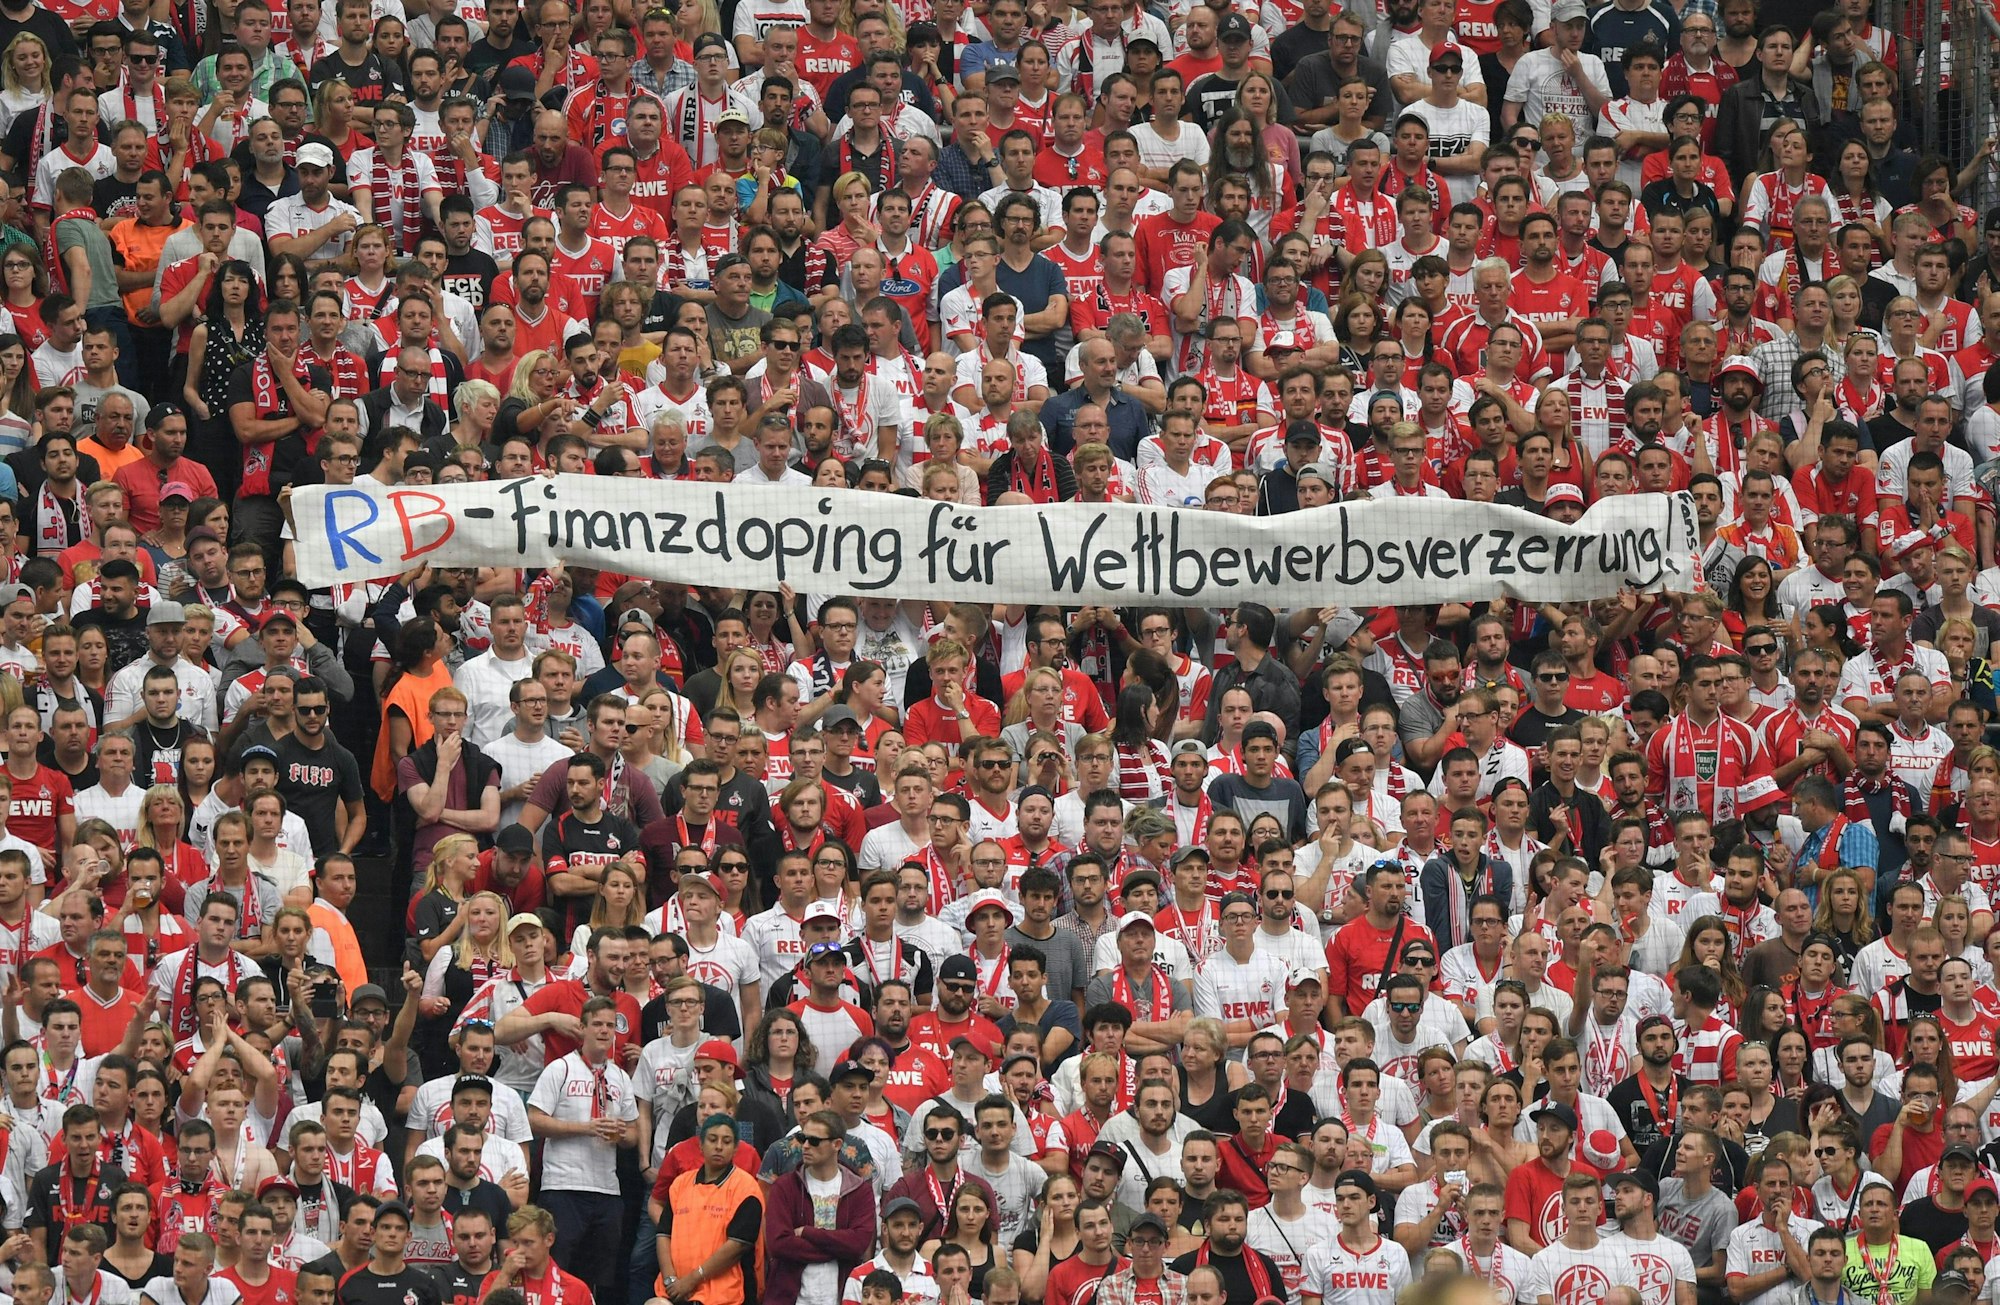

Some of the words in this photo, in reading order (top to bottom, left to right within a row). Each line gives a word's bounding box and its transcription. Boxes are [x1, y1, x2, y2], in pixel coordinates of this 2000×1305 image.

[1459, 22, 1498, 37] REW
[1601, 48, 1623, 62] RE
[806, 58, 851, 73] REWE
[352, 85, 382, 101] EWE
[408, 136, 447, 150] REW
[494, 235, 521, 249] RE
[445, 277, 484, 293] FCK
[578, 278, 601, 290] WE
[883, 279, 914, 293] Ford
[1447, 294, 1479, 305] EWE
[1662, 293, 1685, 308] WE
[351, 308, 372, 320] RE
[1583, 407, 1608, 419] EW
[325, 477, 902, 589] RB-Finanzdoping
[919, 502, 1011, 585] für
[1039, 494, 1681, 597] Wettbewerbsverzerrung!
[767, 759, 794, 773] EW
[9, 801, 52, 816] EWE
[713, 811, 739, 826] WE
[1971, 866, 2000, 881] REW
[777, 941, 807, 953] REW
[0, 949, 19, 964] EW
[1952, 1041, 1993, 1056] EWE
[1752, 1250, 1786, 1263] REW
[1332, 1273, 1388, 1289] REWE
